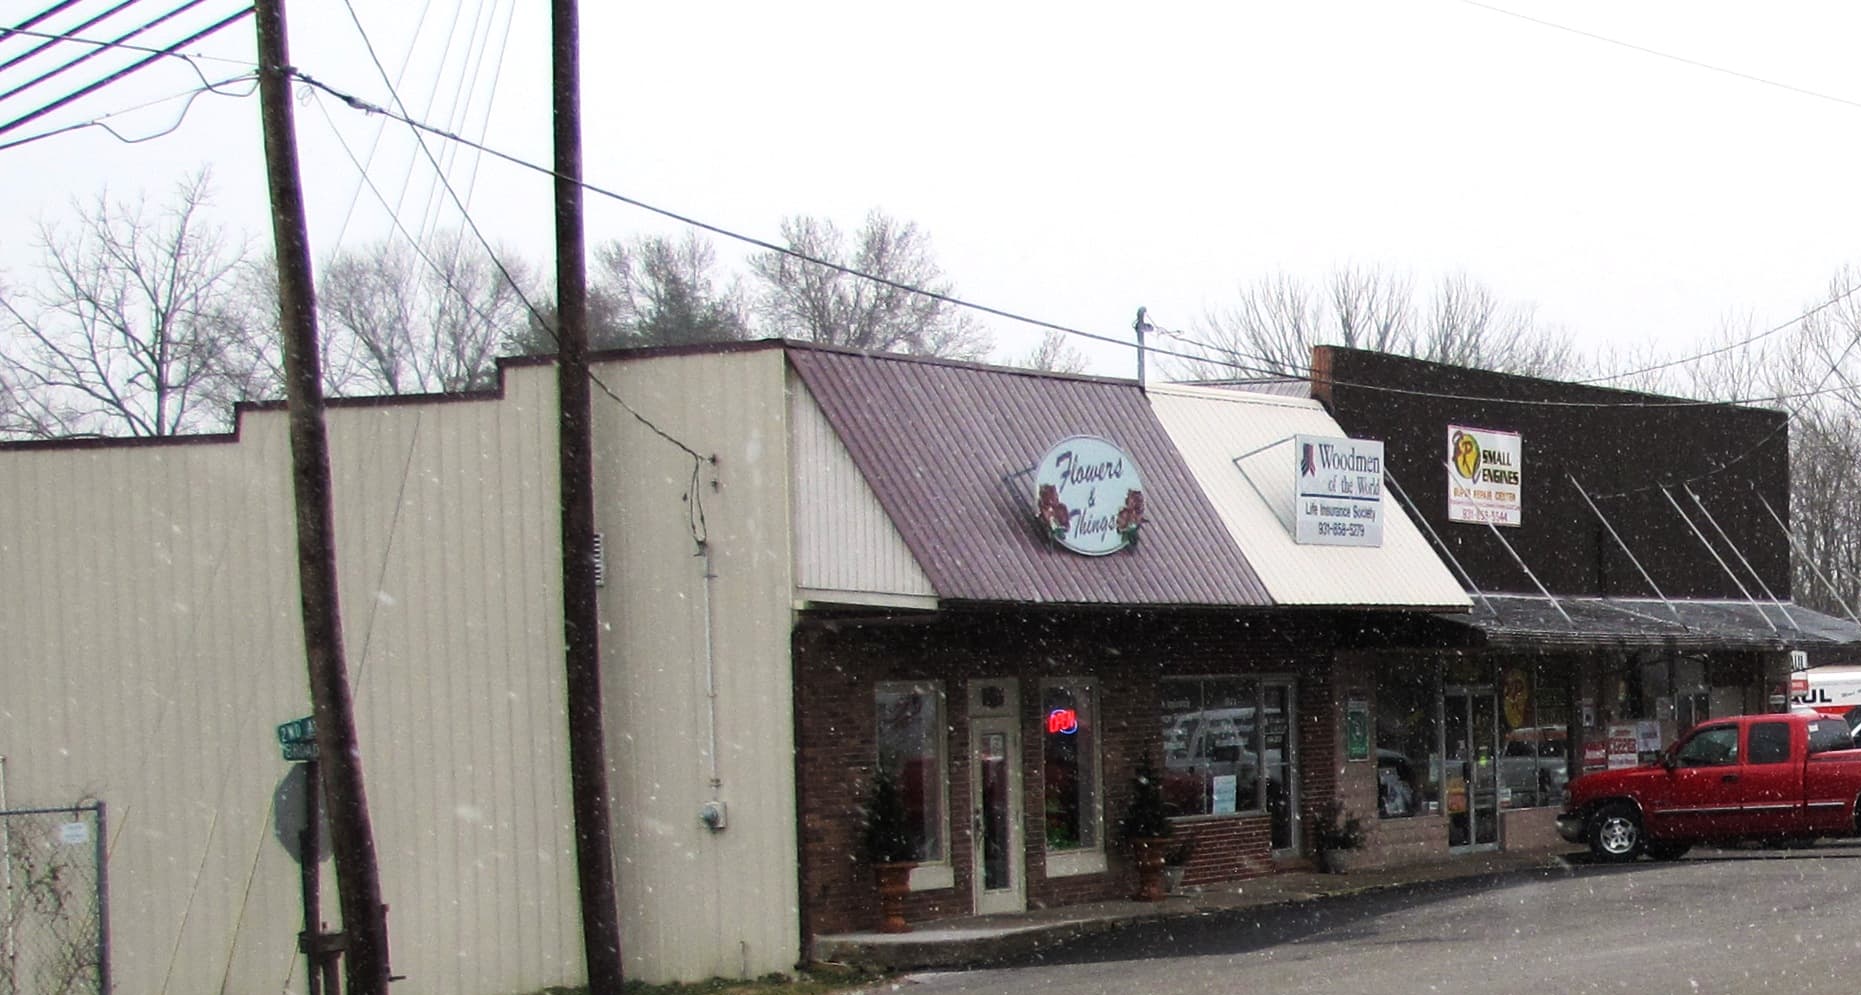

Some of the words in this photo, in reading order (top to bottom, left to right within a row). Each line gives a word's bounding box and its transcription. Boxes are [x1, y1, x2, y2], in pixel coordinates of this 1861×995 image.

[1318, 443, 1380, 473] Woodmen
[1482, 449, 1512, 466] SMALL
[1055, 451, 1122, 493] Flowers
[1482, 468, 1519, 485] ENGINES
[1328, 475, 1337, 493] of
[1341, 475, 1353, 494] the
[1357, 476, 1380, 496] World
[1305, 502, 1318, 516] Life
[1320, 503, 1351, 518] Insurance
[1353, 505, 1376, 522] Society
[1070, 508, 1116, 543] Things
[1048, 709, 1075, 733] OPEN
[281, 722, 301, 742] 2ND
